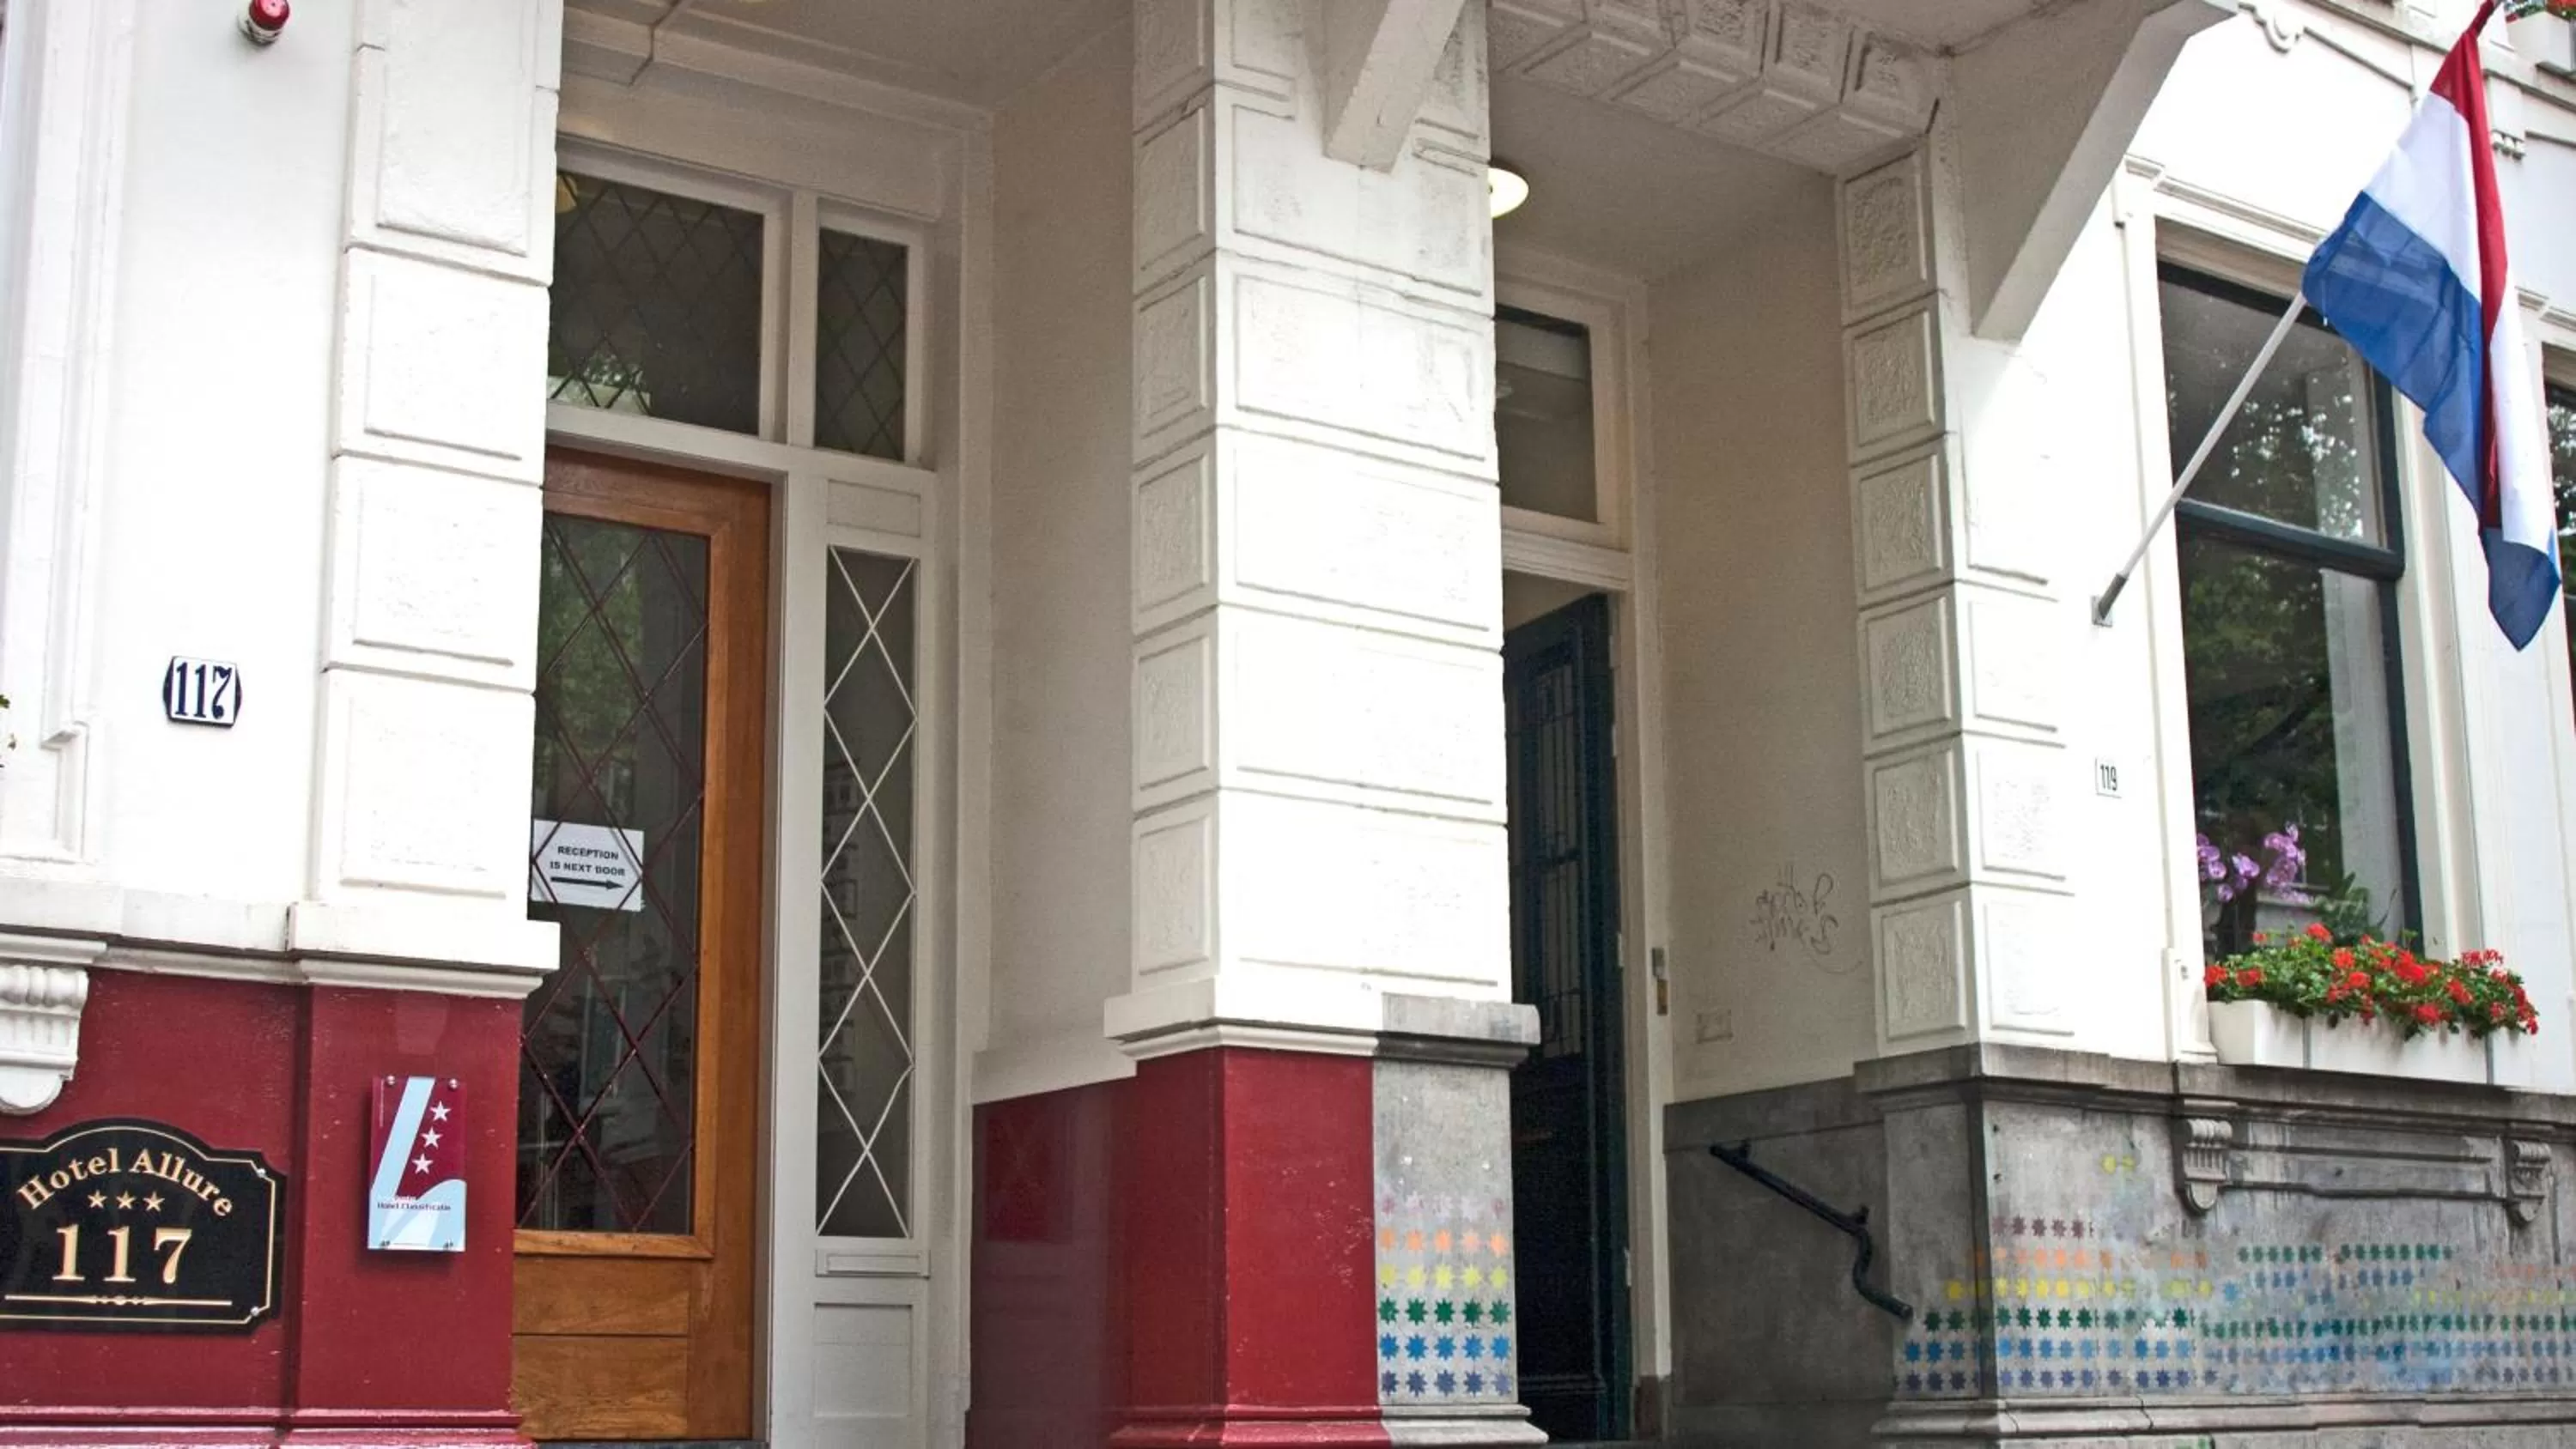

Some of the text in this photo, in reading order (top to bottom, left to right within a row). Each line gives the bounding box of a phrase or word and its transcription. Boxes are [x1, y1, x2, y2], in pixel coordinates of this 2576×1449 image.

[174, 661, 233, 719] 117
[2100, 764, 2117, 791] 119
[550, 861, 626, 876] IS NEXT DOOR
[558, 846, 619, 860] RECEPTION
[17, 1147, 233, 1216] Hotel Allure
[52, 1223, 192, 1284] 117
